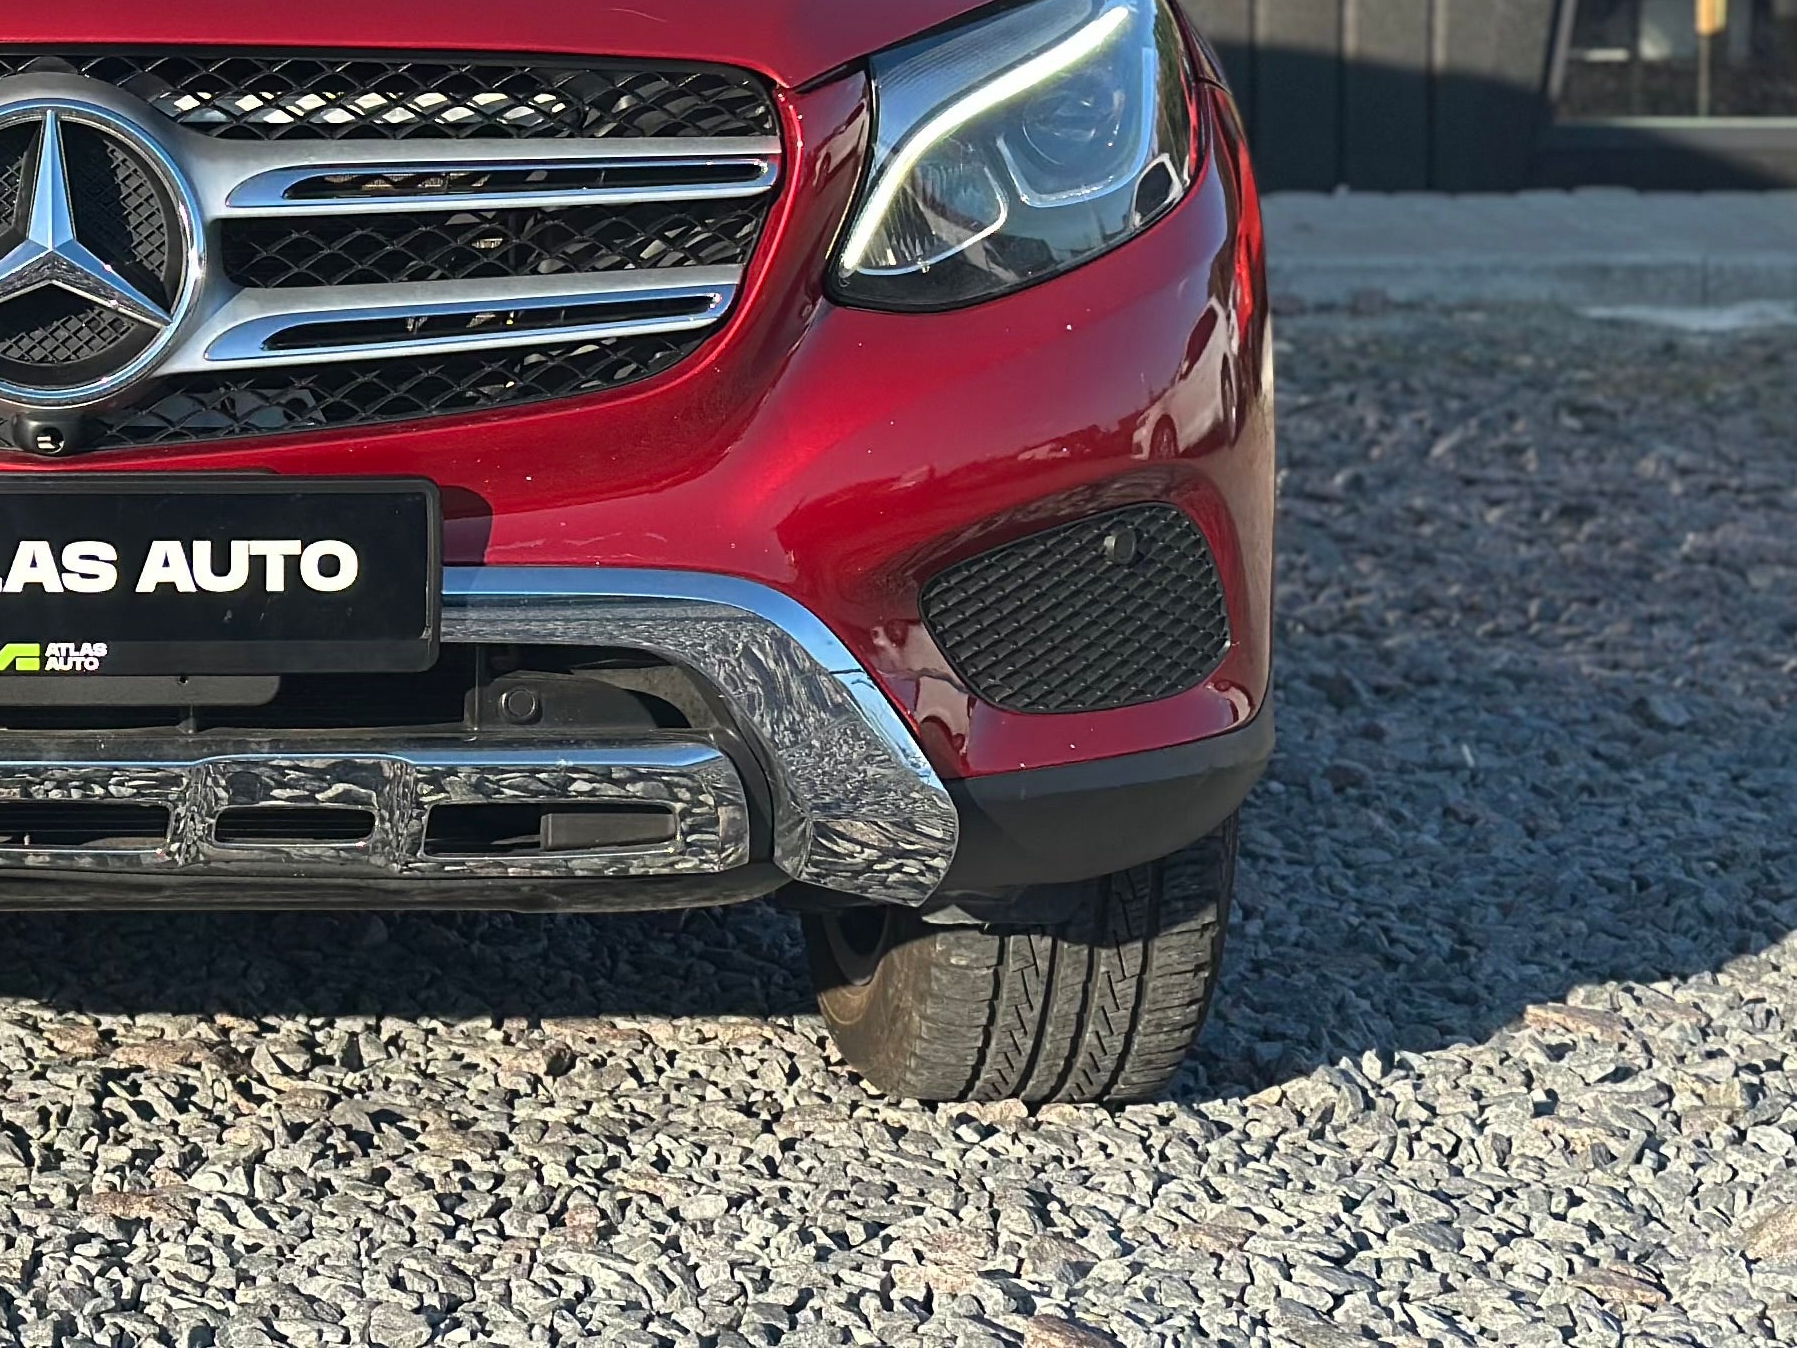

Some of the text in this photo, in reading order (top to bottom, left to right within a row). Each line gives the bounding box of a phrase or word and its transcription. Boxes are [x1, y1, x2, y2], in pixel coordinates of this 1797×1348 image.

[136, 540, 358, 592] AUTO
[45, 643, 107, 657] ATLAS
[45, 657, 99, 670] AUTO
